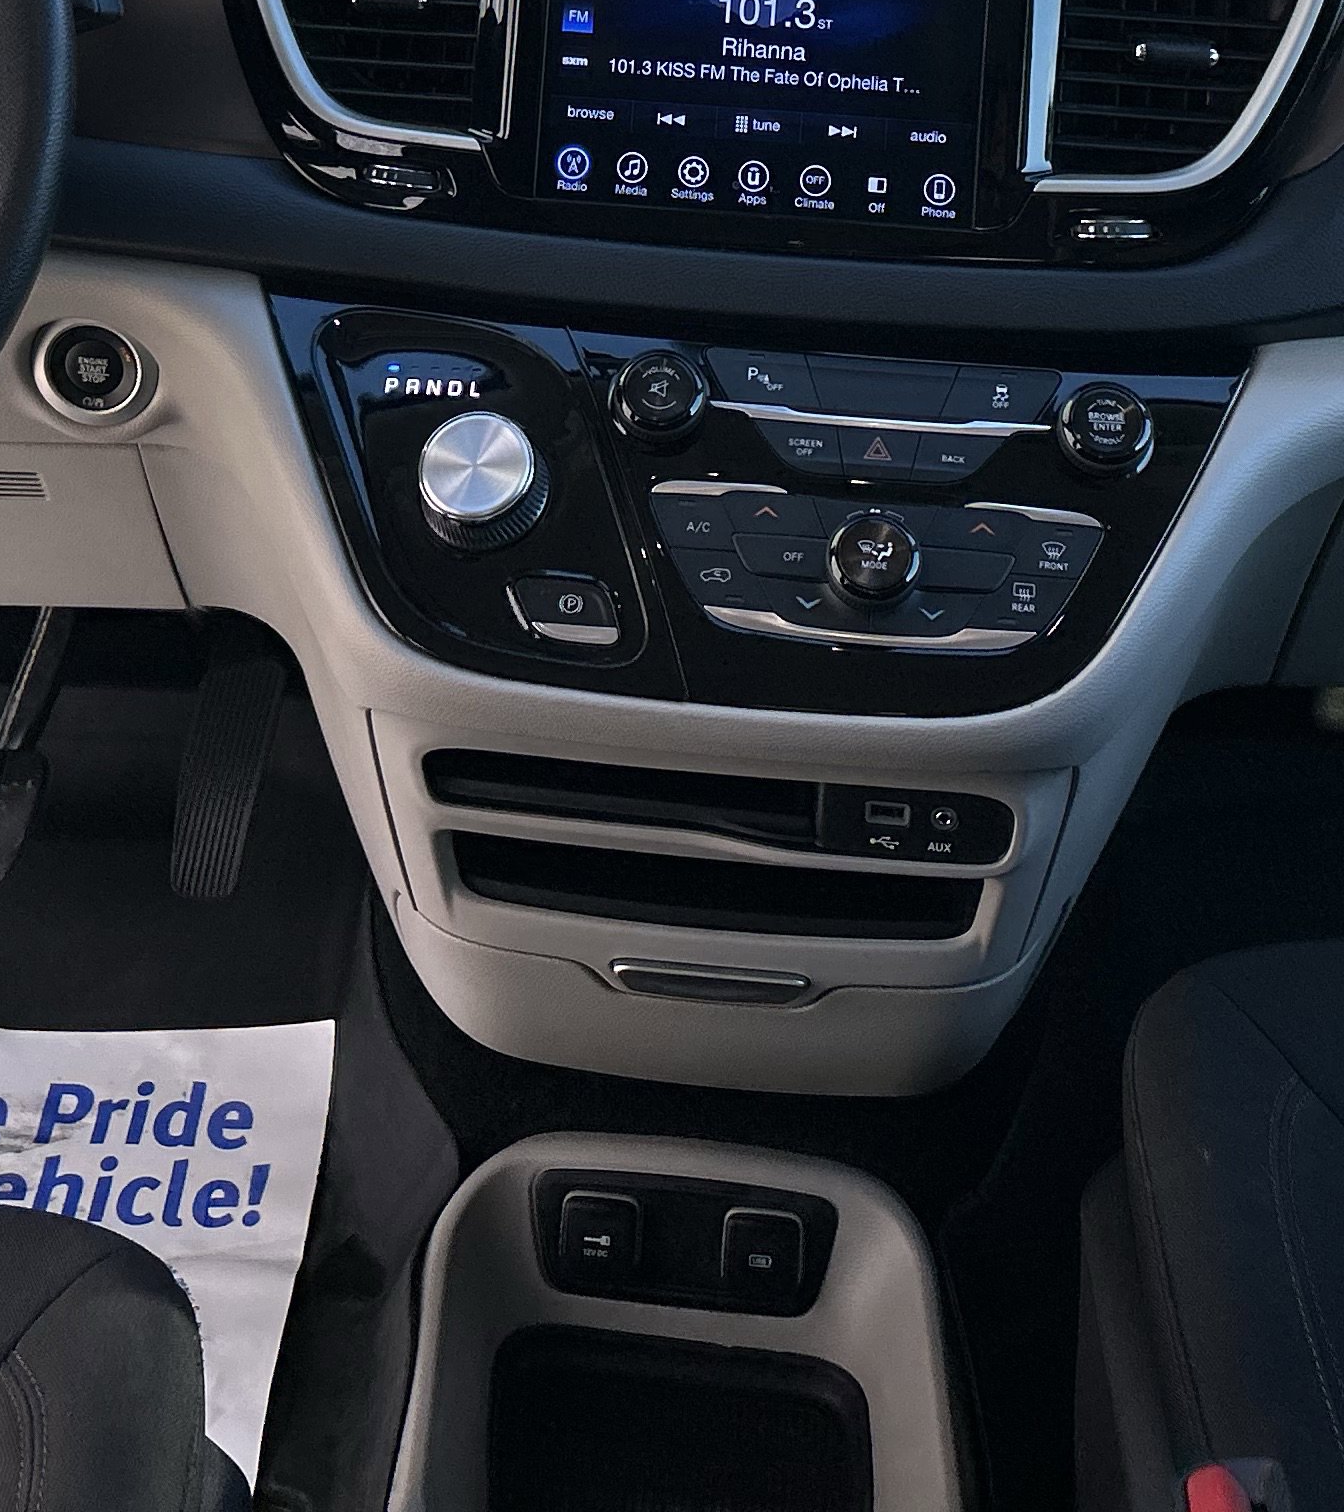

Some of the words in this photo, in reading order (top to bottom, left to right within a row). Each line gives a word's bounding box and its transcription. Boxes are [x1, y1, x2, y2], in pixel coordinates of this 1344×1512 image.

[568, 9, 589, 23] FM
[817, 18, 833, 30] ST
[722, 37, 807, 62] Rihanna
[608, 58, 652, 76] 101.3
[656, 61, 696, 79] KISS
[700, 64, 725, 80] FM
[730, 65, 760, 83] The
[764, 68, 800, 86] Fate
[803, 70, 824, 87] Of
[827, 72, 888, 92] Ophelia
[567, 104, 615, 121] browse
[752, 117, 781, 132] tune
[909, 130, 947, 144] audio
[556, 179, 588, 192] Radio
[805, 174, 826, 186] OFF
[614, 184, 648, 197] Media
[670, 188, 715, 202] Settings
[737, 192, 767, 207] Apps
[794, 196, 835, 211] Climate
[868, 202, 886, 214] Off
[921, 205, 956, 219] Phone
[1087, 411, 1125, 422] BROWSE
[1092, 423, 1123, 433] ENTER
[788, 438, 824, 449] SCREEN
[796, 448, 814, 457] OFF
[941, 454, 967, 464] BACK
[685, 521, 712, 534] A/C
[782, 551, 805, 563] OFF
[860, 560, 889, 571] MODE
[1038, 560, 1069, 572] FRONT
[1011, 603, 1036, 613] REAR
[927, 841, 953, 854] AUX
[33, 1080, 254, 1151] Pride
